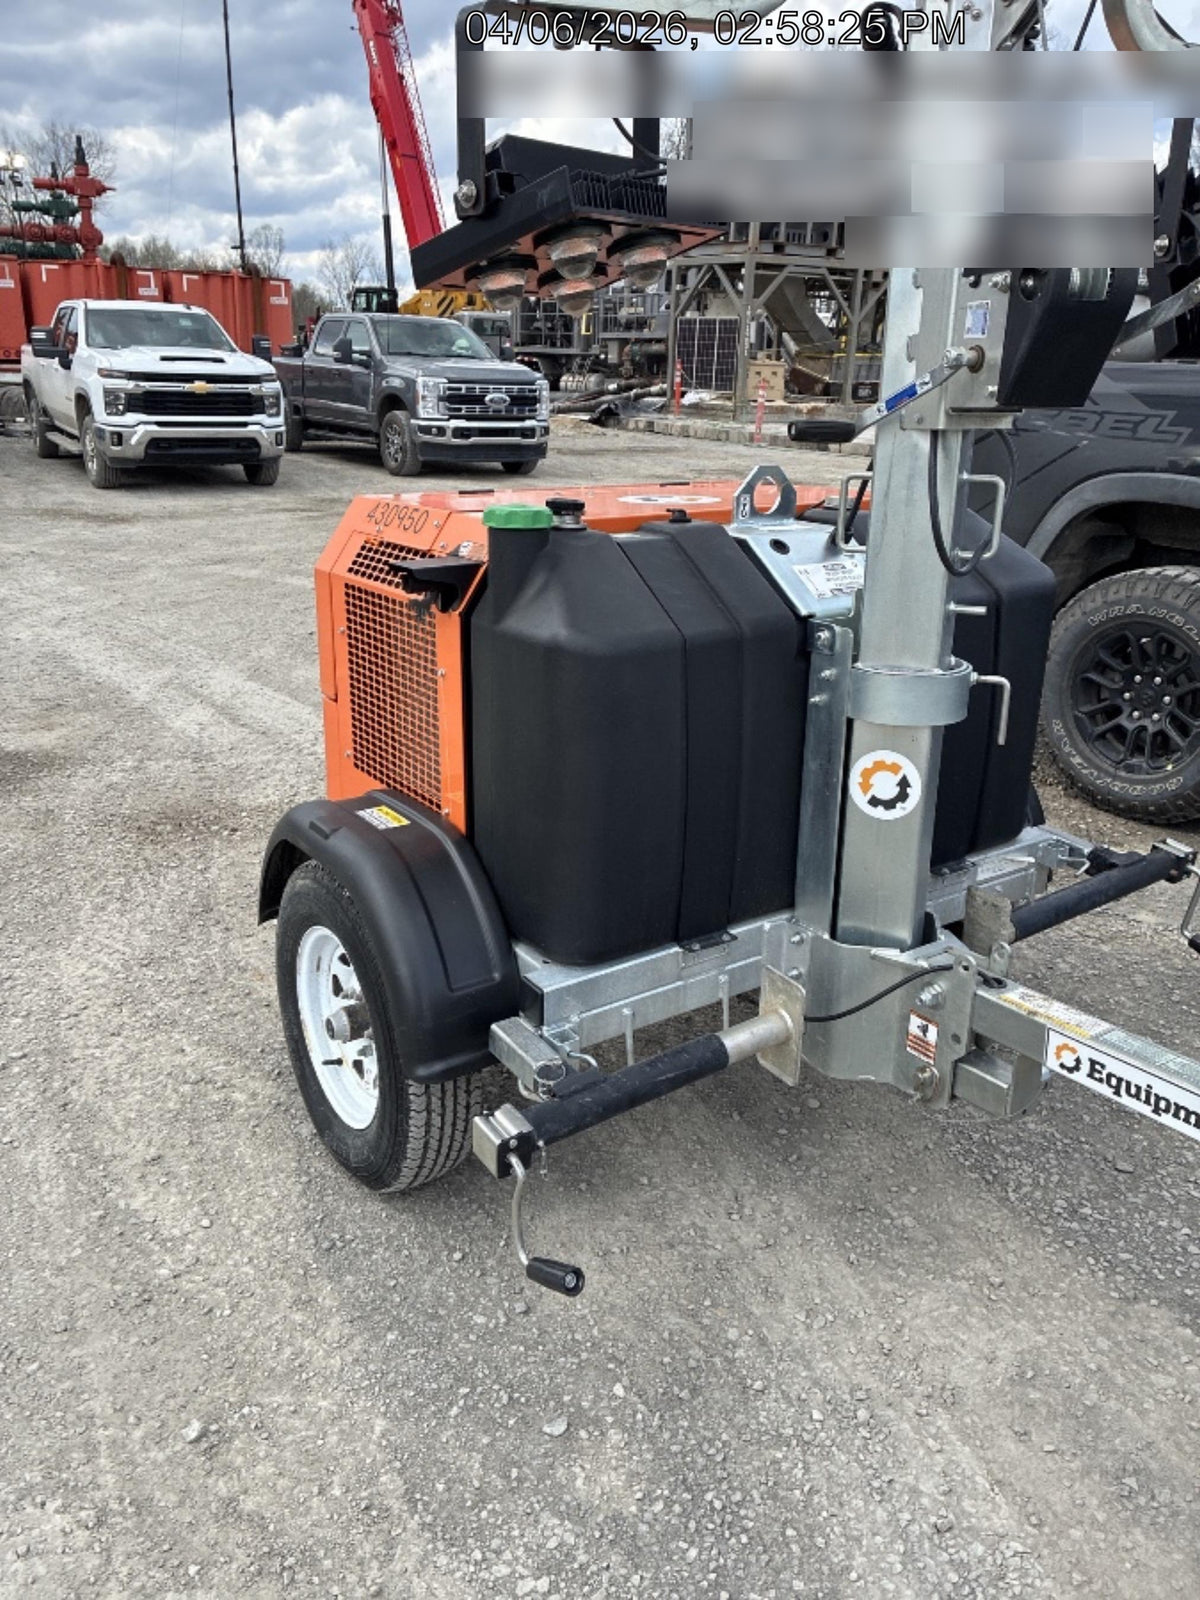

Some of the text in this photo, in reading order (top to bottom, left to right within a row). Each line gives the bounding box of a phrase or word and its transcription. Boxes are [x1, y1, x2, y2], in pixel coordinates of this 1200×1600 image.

[367, 501, 429, 534] 430950
[1087, 603, 1200, 646] WRANGL
[1086, 1057, 1200, 1130] Equipm
